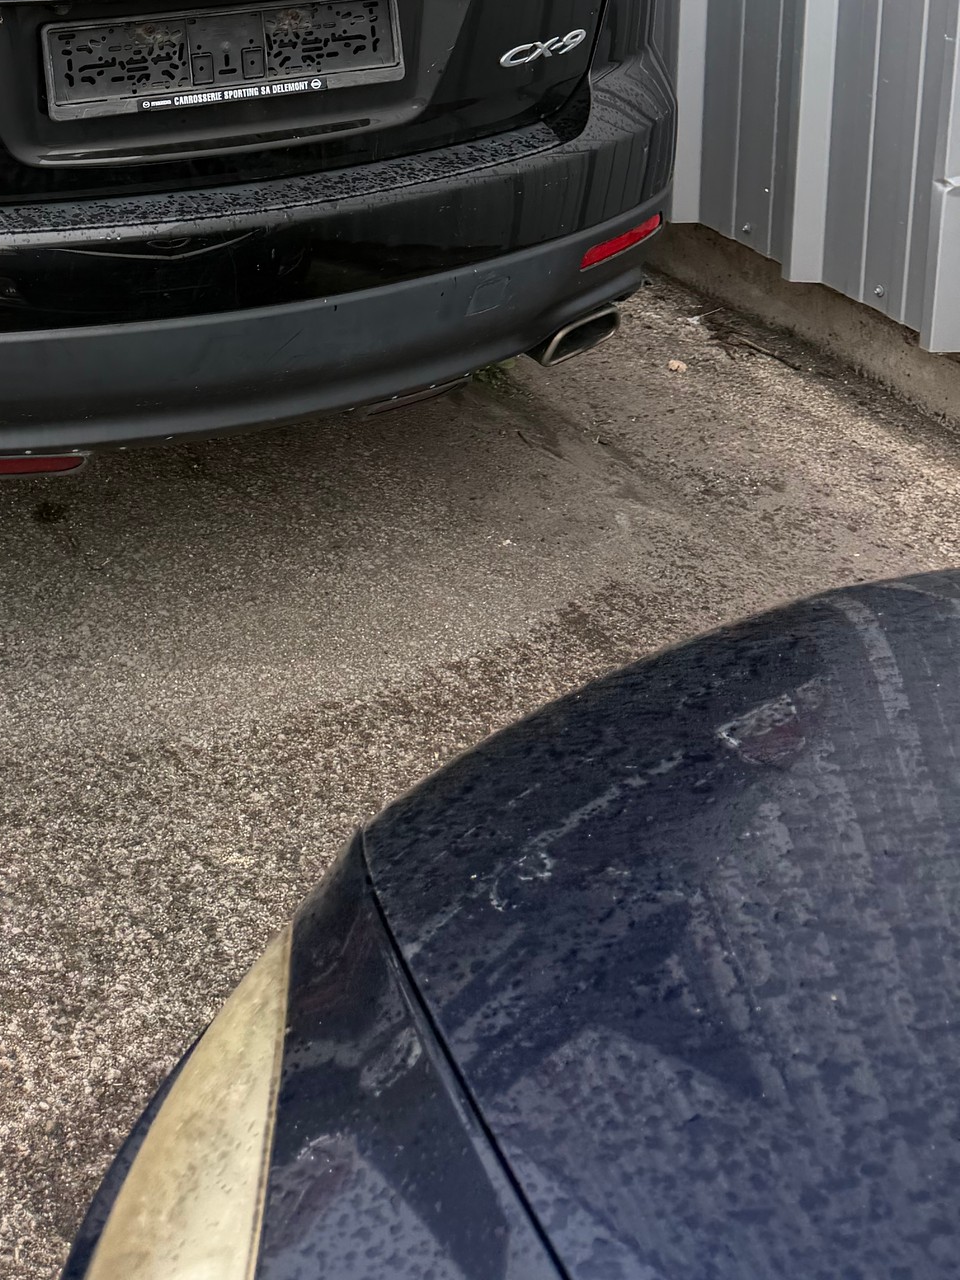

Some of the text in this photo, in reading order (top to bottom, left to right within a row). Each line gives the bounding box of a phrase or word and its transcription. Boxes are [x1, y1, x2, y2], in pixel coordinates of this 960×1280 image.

[500, 29, 587, 67] CX-9
[174, 91, 222, 106] CARROSSERIE
[224, 87, 259, 101] SPORTING
[261, 86, 271, 96] SA
[272, 80, 309, 95] DELEMONT
